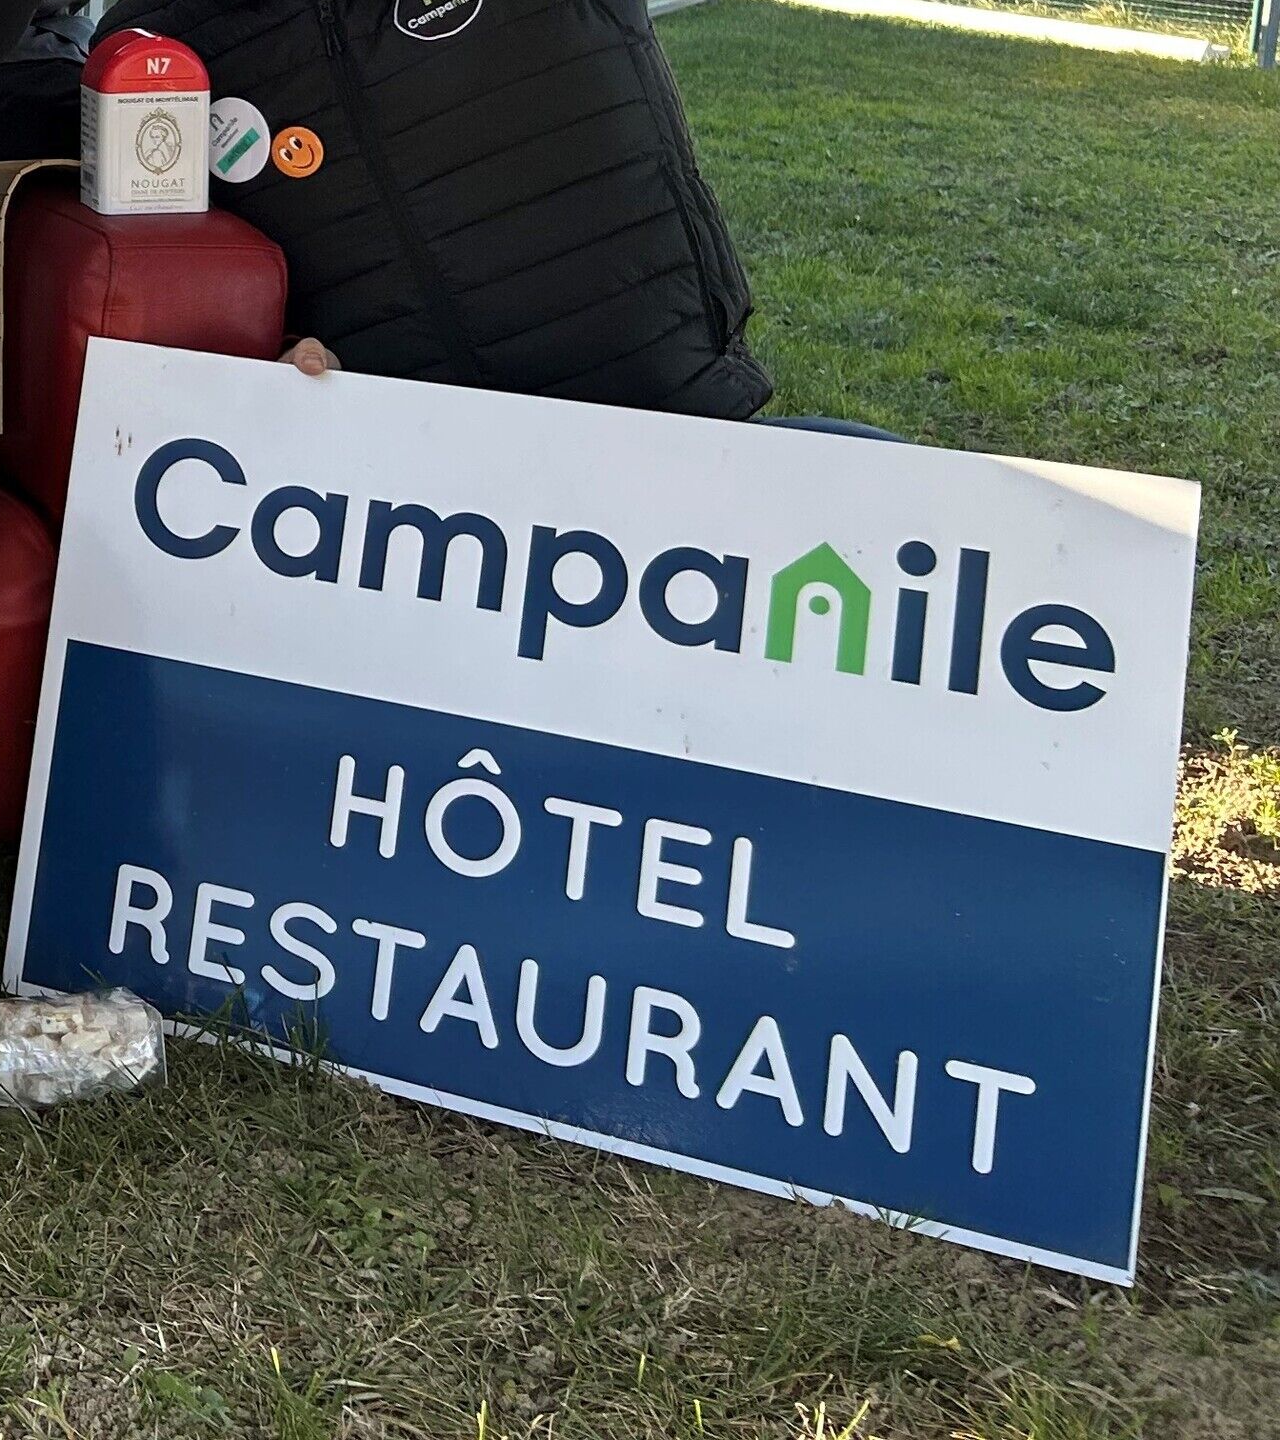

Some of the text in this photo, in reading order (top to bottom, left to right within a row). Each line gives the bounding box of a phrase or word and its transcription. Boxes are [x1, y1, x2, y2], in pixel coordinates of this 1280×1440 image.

[146, 58, 171, 75] N7
[131, 178, 185, 188] NOUGAT
[134, 438, 1116, 712] Campanile
[330, 748, 796, 949] HÔTEL
[107, 863, 1036, 1175] RESTAURANT
